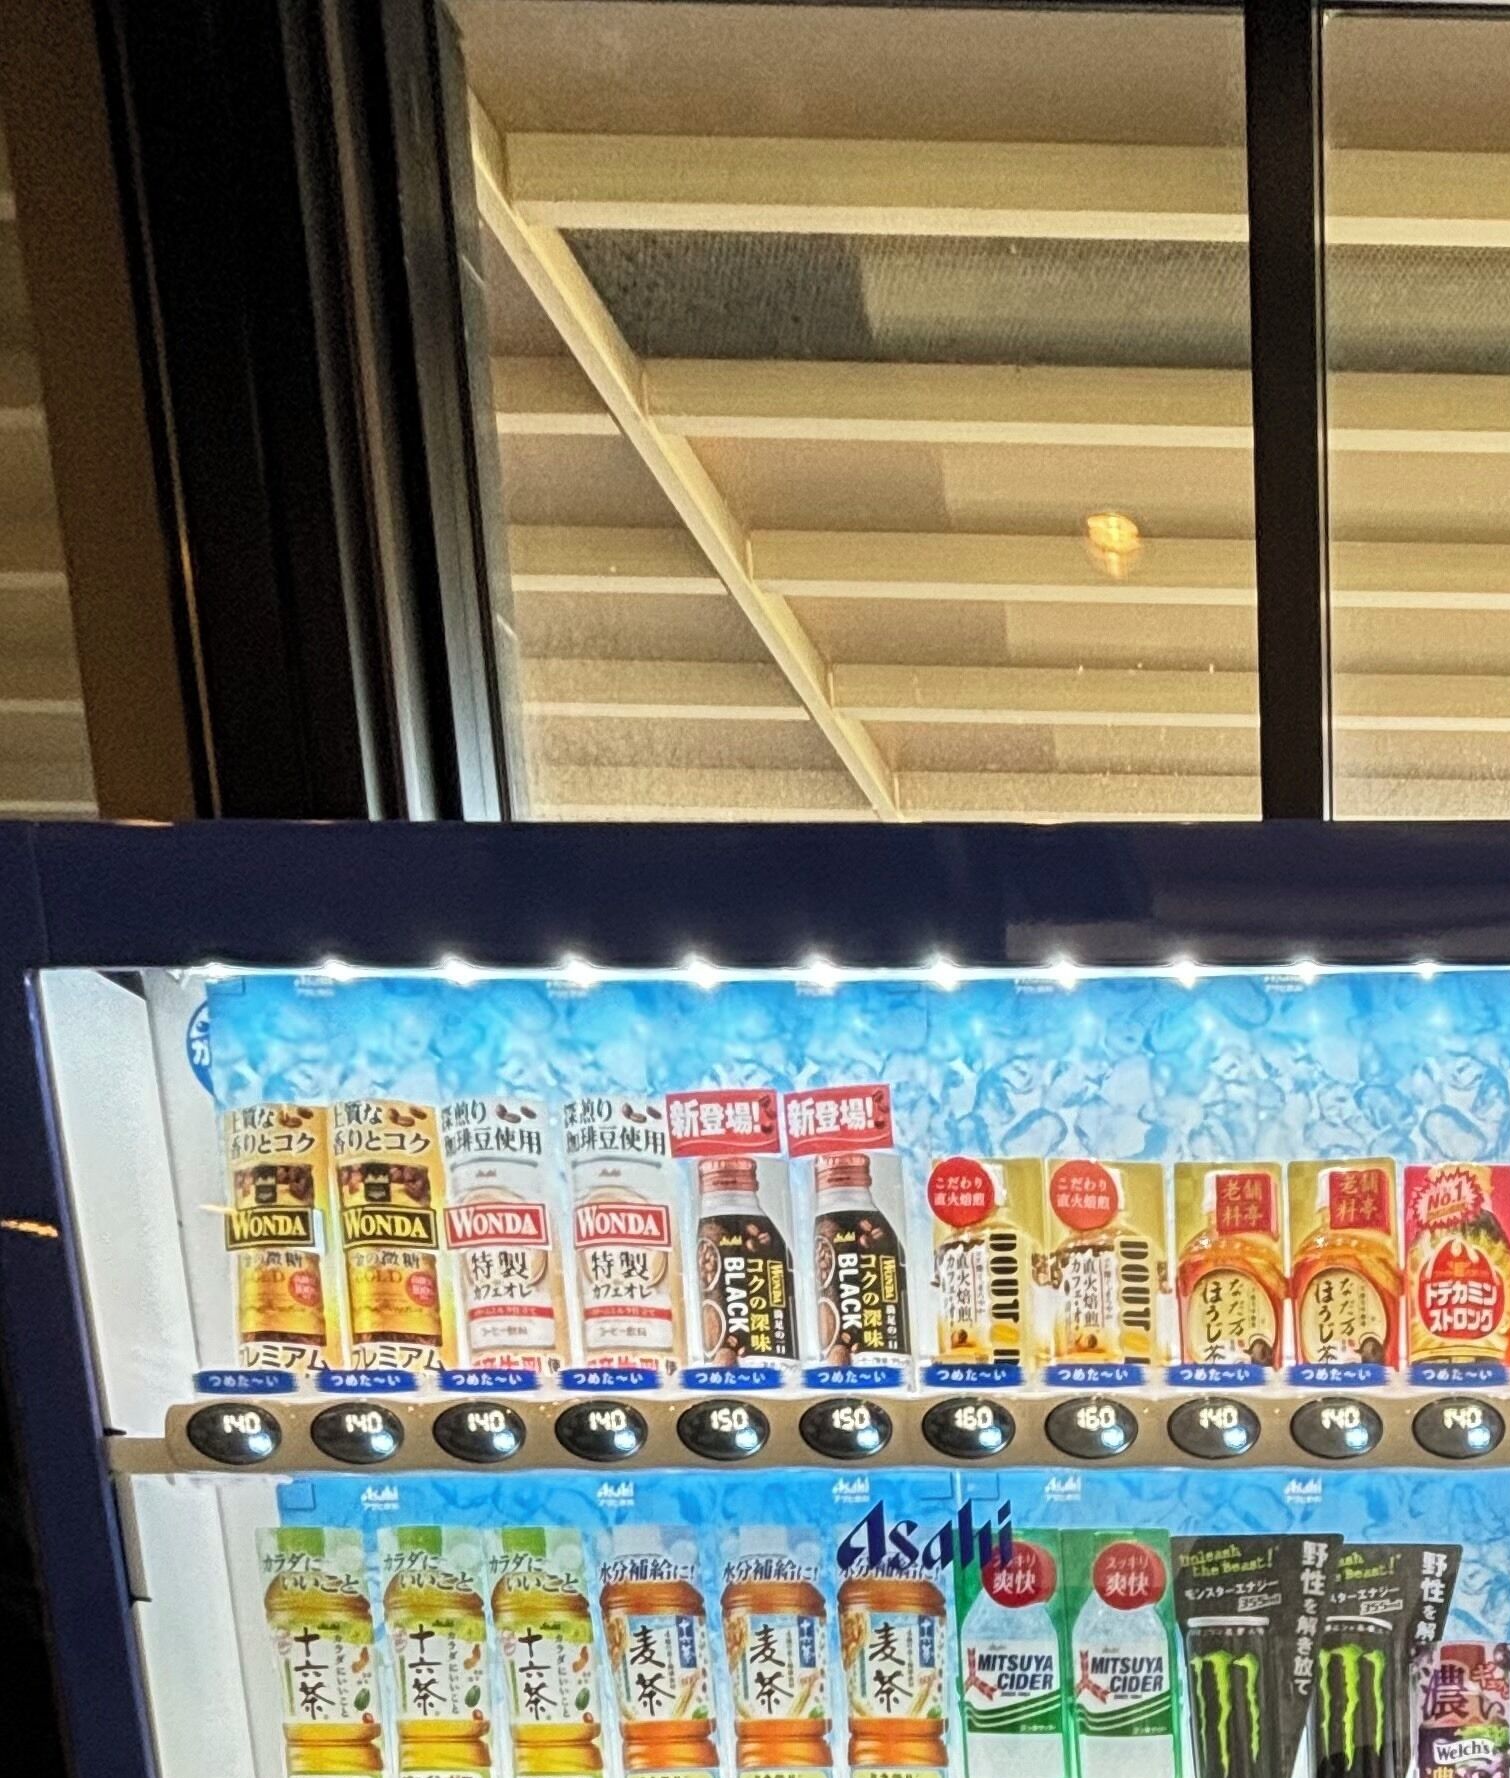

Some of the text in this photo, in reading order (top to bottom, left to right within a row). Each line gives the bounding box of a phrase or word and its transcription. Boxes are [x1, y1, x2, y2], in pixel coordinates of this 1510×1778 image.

[935, 1176, 983, 1190] こだわり
[1057, 1177, 1107, 1191] こだわり
[230, 1209, 307, 1242] WONDA
[344, 1208, 429, 1241] WONDA
[450, 1206, 538, 1240] WONDA
[576, 1205, 660, 1239] WONDA
[471, 1250, 529, 1281] 特製
[592, 1250, 650, 1281] 特製
[473, 1282, 533, 1300] カフェオレ
[592, 1282, 652, 1299] カフェオレ
[723, 1256, 750, 1334] BLACK
[837, 1252, 863, 1330] BLACK
[860, 1253, 885, 1349] コクの深味
[747, 1258, 772, 1353] コクの深味
[1429, 1309, 1494, 1334] ストロング
[223, 1411, 261, 1434] 140
[346, 1411, 384, 1434] 140
[467, 1410, 506, 1433] 140
[588, 1409, 627, 1432] 140
[710, 1408, 749, 1432] 150
[832, 1406, 871, 1432] 150
[954, 1406, 993, 1431] 160
[1077, 1405, 1115, 1431] 160
[1199, 1407, 1238, 1430] 140
[1321, 1406, 1360, 1430] 140
[1443, 1406, 1483, 1430] 140
[837, 1499, 1013, 1571] Asahi
[992, 1571, 1036, 1595] 爽快
[1105, 1571, 1149, 1597] 爽快
[294, 1627, 335, 1721] 十六茶
[408, 1623, 447, 1718] 十六茶
[518, 1627, 557, 1721] 十六茶
[630, 1624, 676, 1717] 麦茶
[750, 1623, 794, 1714] 麦茶
[869, 1622, 913, 1713] 麦茶
[977, 1654, 1053, 1672] MITSUYA
[1091, 1656, 1164, 1675] MITSUYA
[997, 1673, 1053, 1690] CIDER
[1110, 1675, 1164, 1693] CIDER
[1436, 1741, 1491, 1762] Welch's
